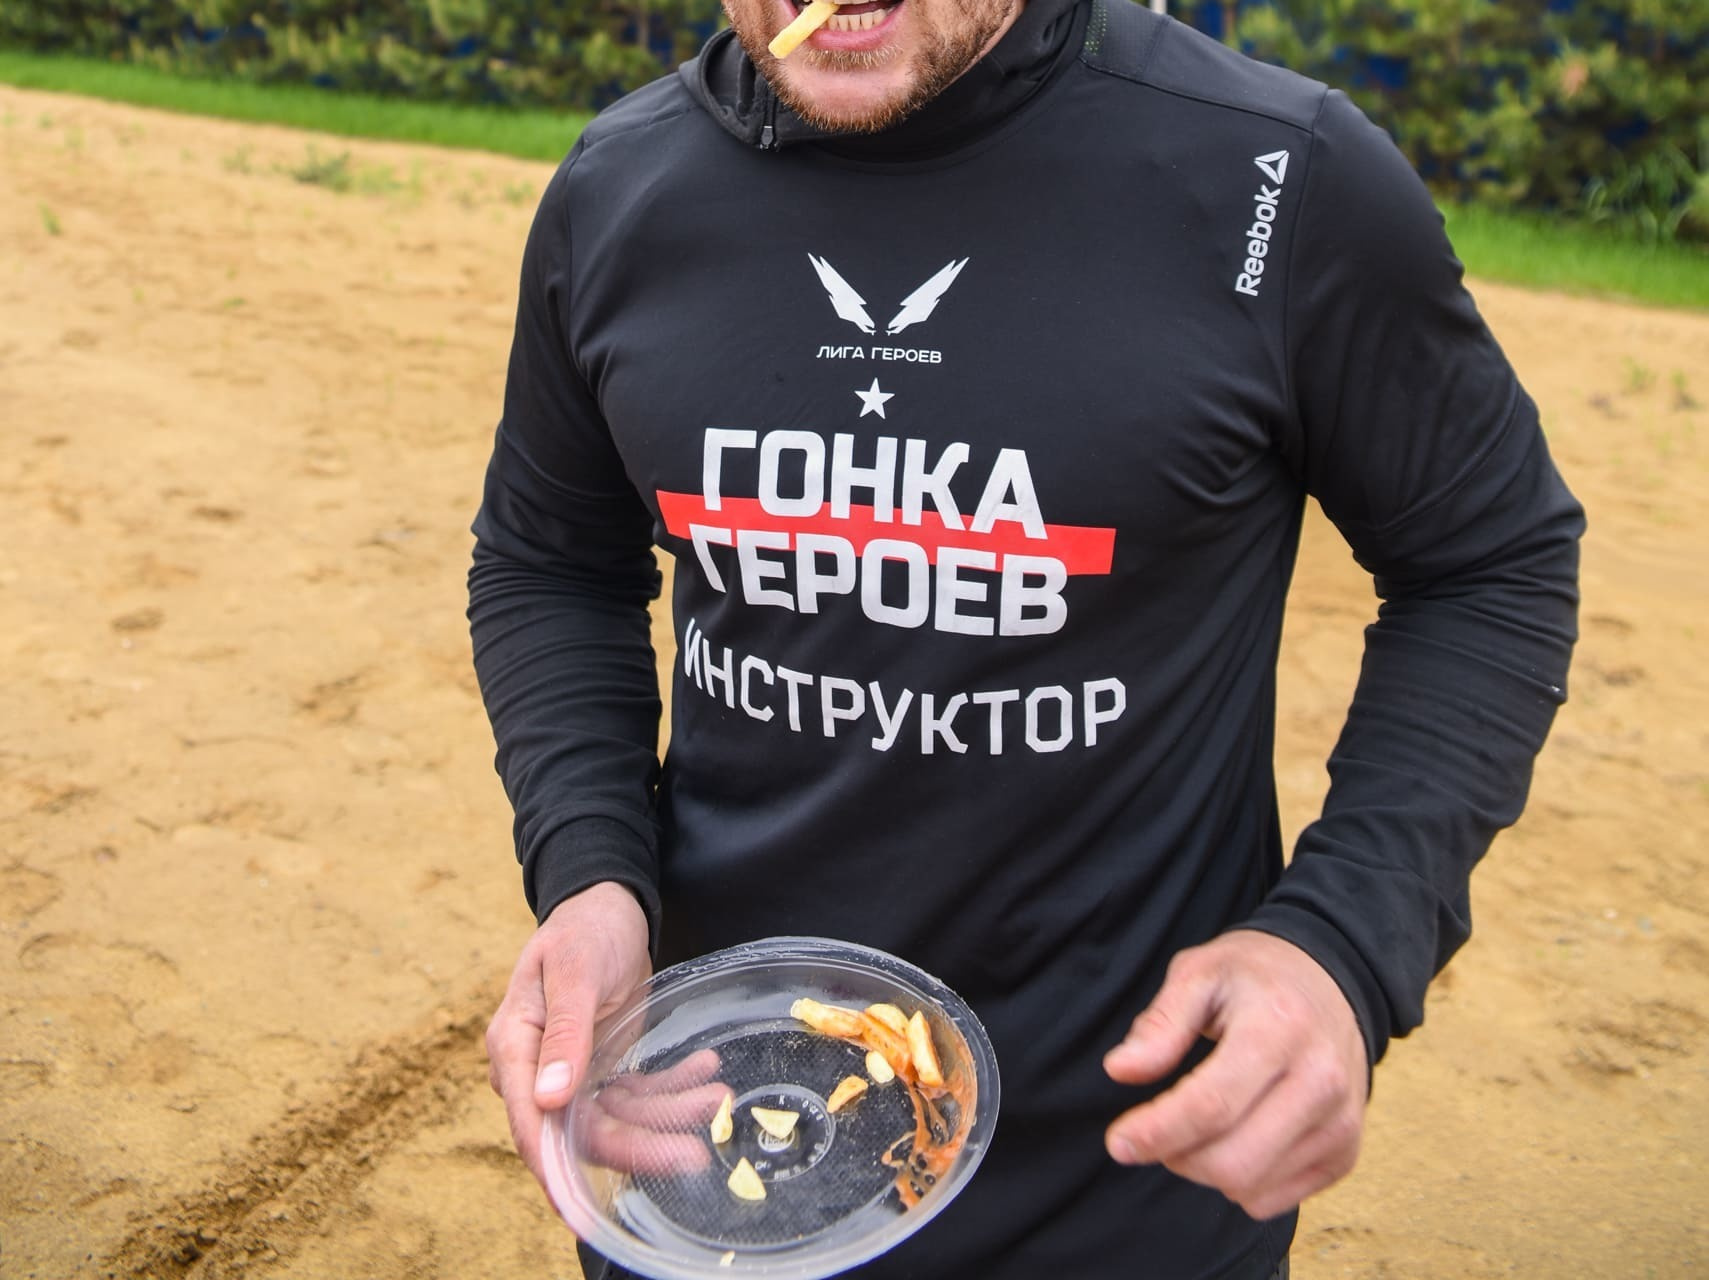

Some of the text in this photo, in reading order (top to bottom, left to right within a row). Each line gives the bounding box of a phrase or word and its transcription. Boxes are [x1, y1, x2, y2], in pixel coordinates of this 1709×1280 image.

[1235, 184, 1281, 296] Reebok
[816, 346, 942, 363] ЛИГА ГЕРОЕВ
[703, 428, 1047, 539] ГОНКА
[689, 523, 1068, 636] ГЕРОЕВ
[684, 617, 1126, 755] ИНСТРУКТОР
